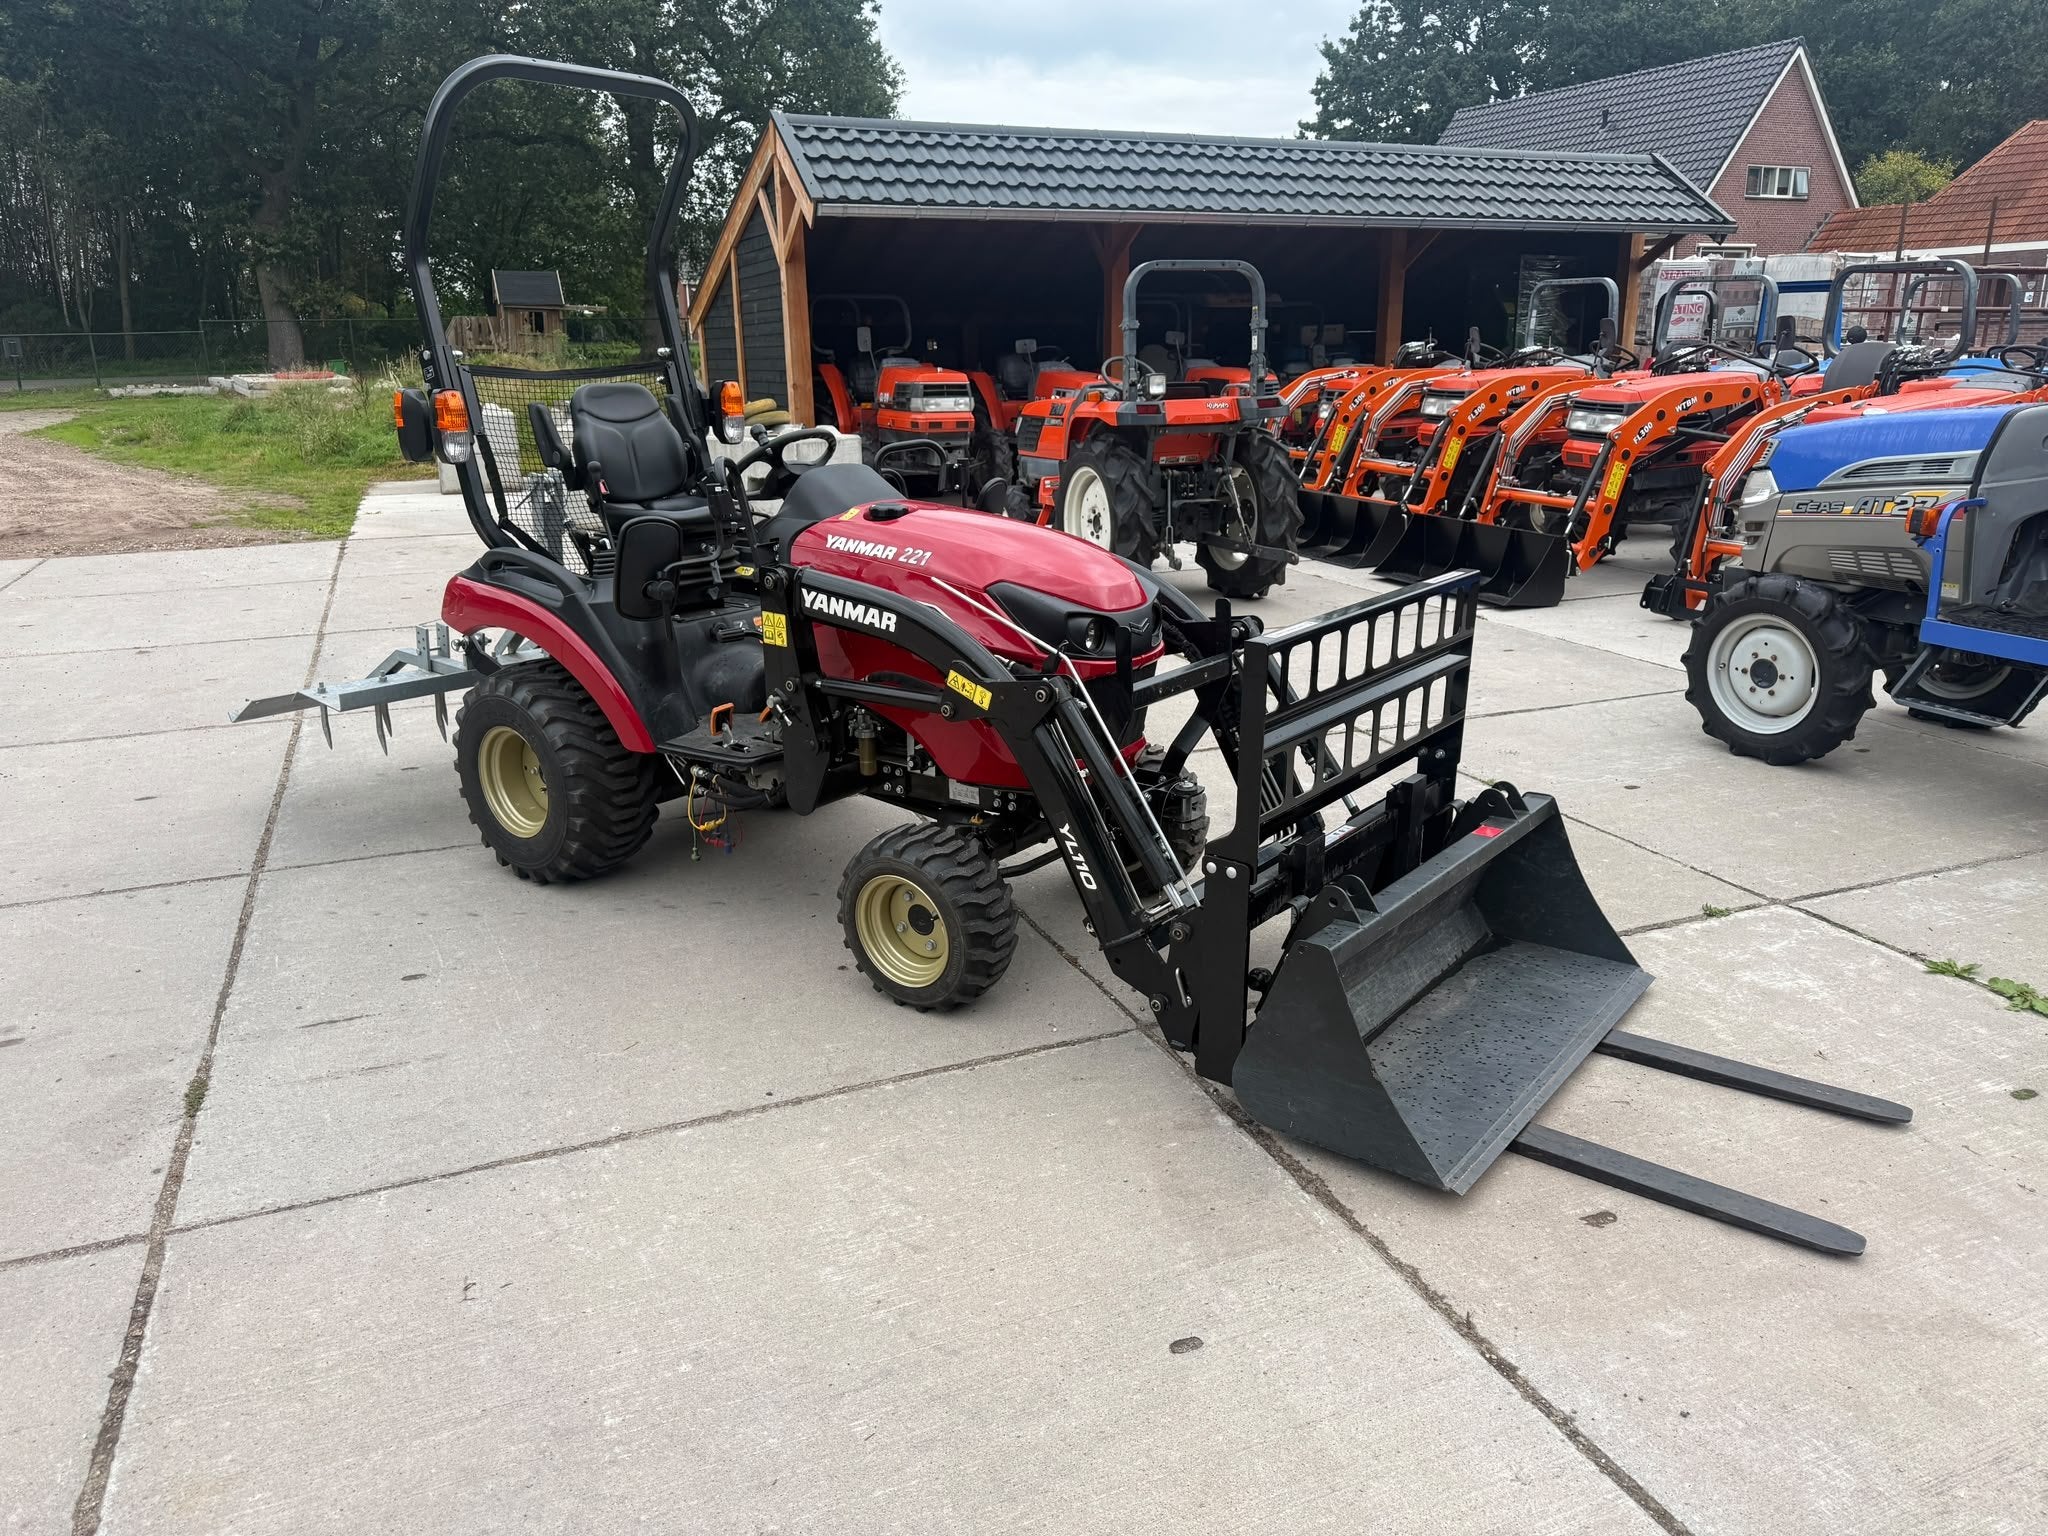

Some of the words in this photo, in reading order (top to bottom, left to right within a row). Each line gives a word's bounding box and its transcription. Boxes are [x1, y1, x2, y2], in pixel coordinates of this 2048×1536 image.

[1673, 303, 1704, 314] ATING
[1467, 402, 1486, 423] FL300
[1674, 396, 1698, 413] WTBM
[1633, 421, 1653, 445] FL300
[825, 533, 898, 561] YANMAR
[898, 547, 932, 566] 221
[801, 587, 898, 633] YANMAR
[1058, 822, 1098, 890] YL110
